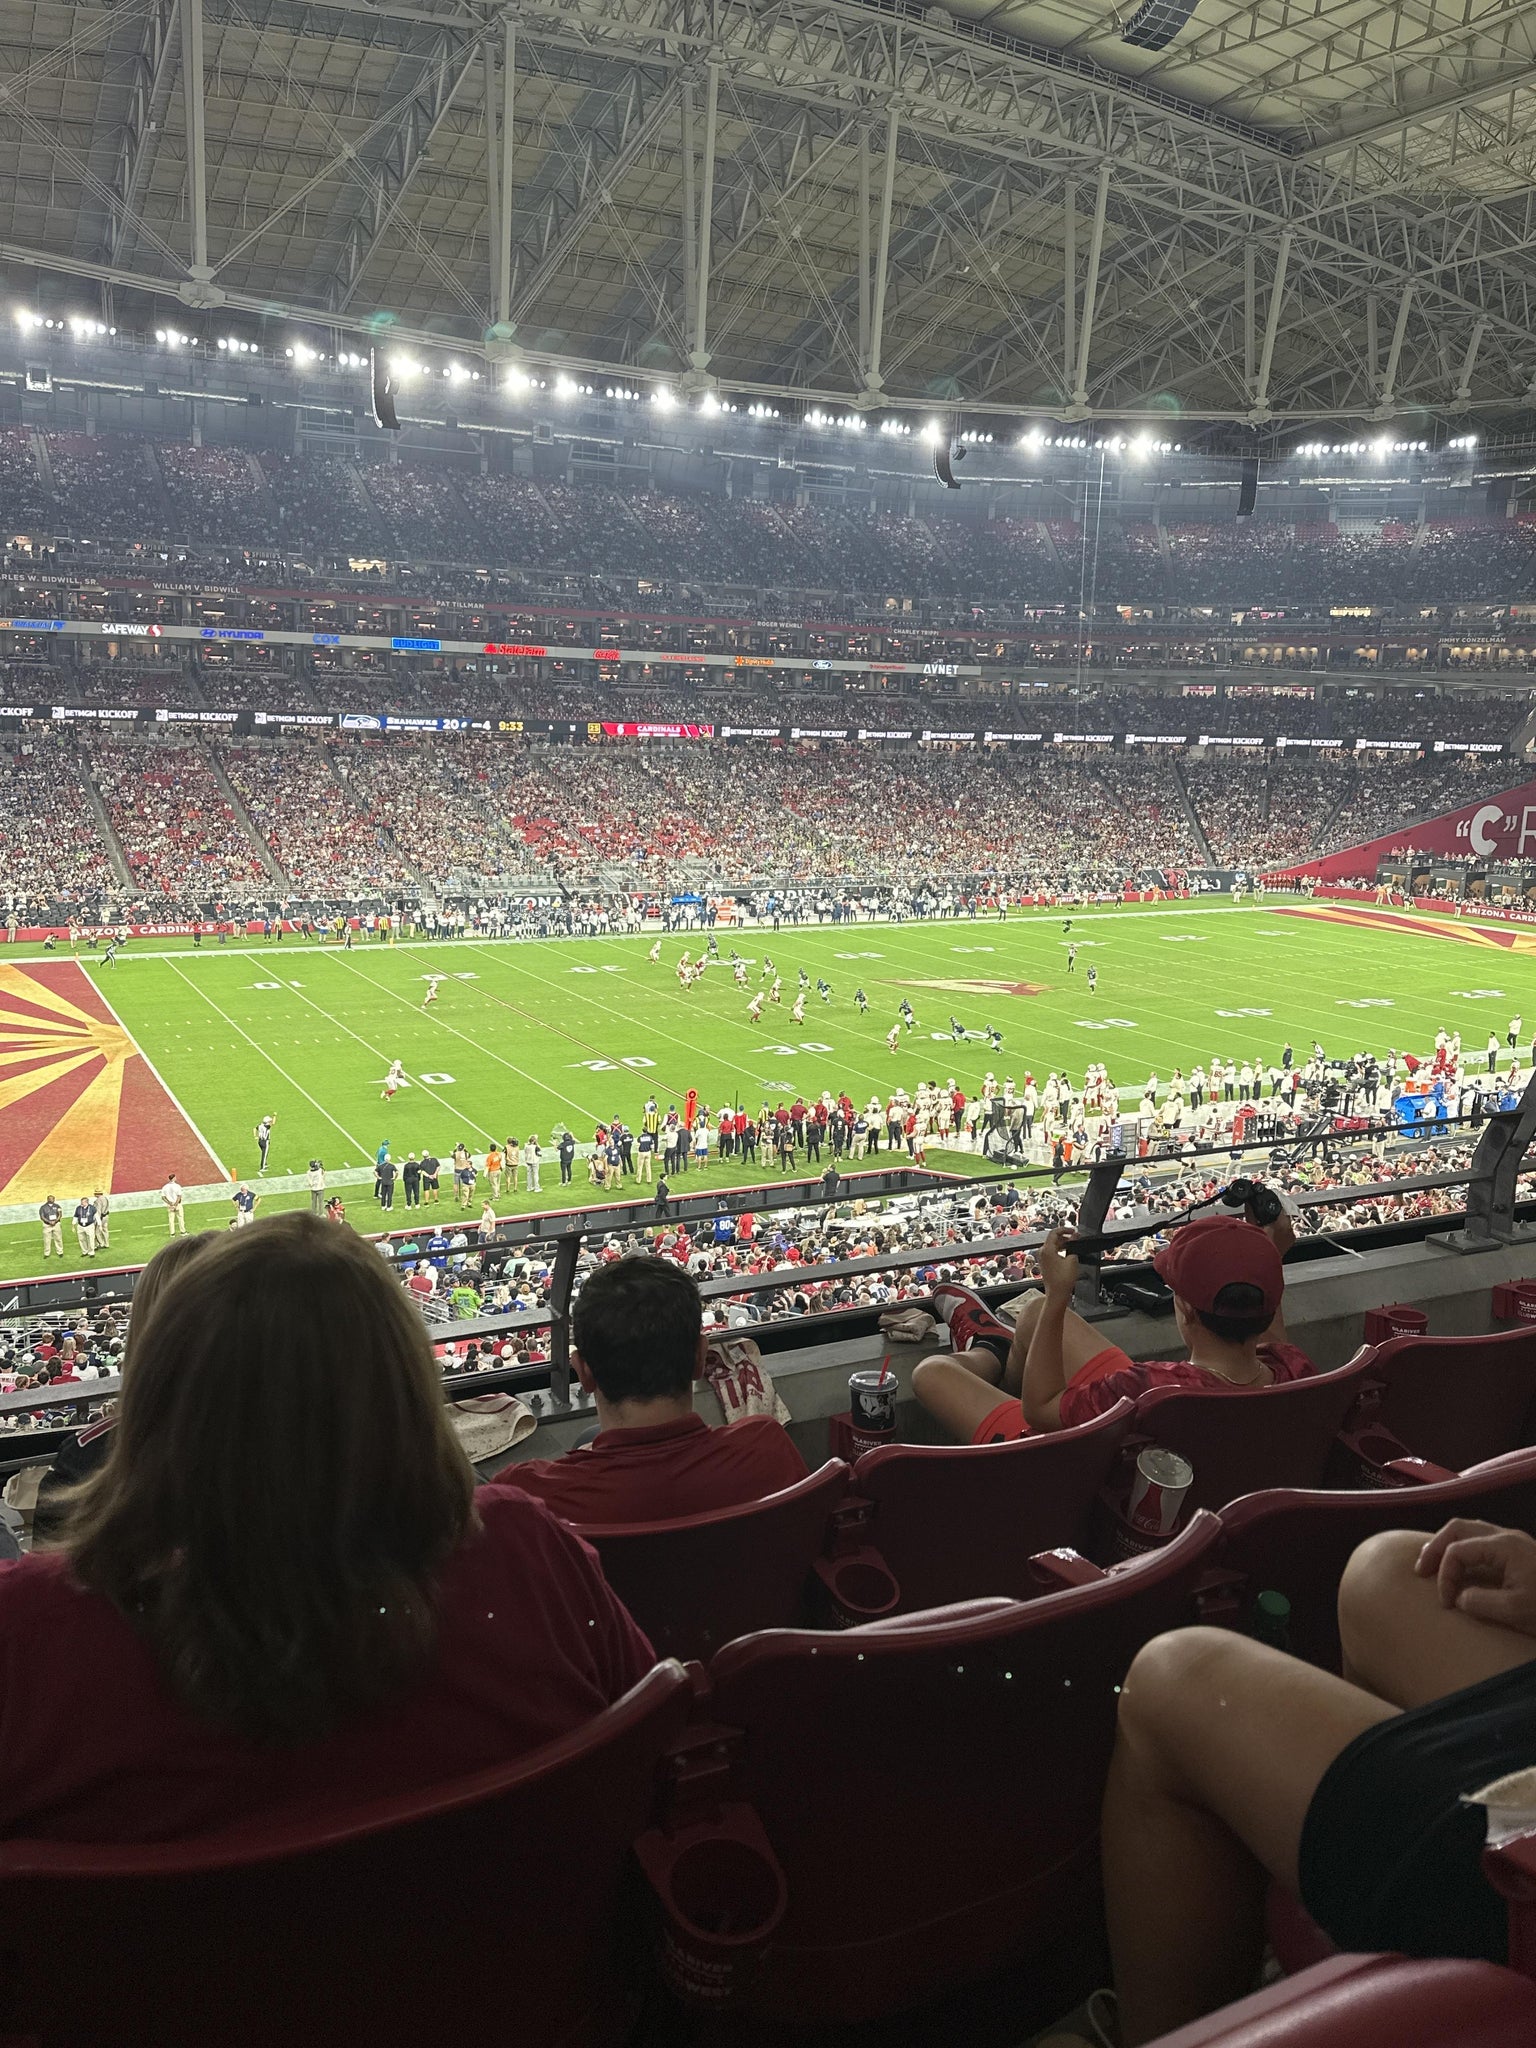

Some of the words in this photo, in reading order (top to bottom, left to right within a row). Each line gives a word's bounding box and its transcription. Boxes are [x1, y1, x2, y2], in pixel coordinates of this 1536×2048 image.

[42, 576, 82, 585] BIDWILL,
[153, 582, 192, 591] WILLIAM
[204, 585, 241, 594] BIDWILL
[452, 601, 485, 609] TILLMAN
[101, 623, 149, 635] SAFEWAY
[757, 620, 778, 628] ROGER
[778, 621, 803, 629] WEHRLI
[218, 630, 264, 640] HYUNDAI
[312, 633, 340, 645] COX
[923, 664, 959, 675] AVNET
[64, 709, 97, 718] BETMGM
[98, 709, 139, 719] KICKOFF
[168, 711, 199, 720] BETMGM
[199, 712, 239, 722] KICKOFF
[266, 714, 296, 723] BETMGM
[296, 715, 334, 724] KICKOFF
[386, 716, 438, 725] SEAHAWKS
[442, 718, 460, 730] 20
[482, 720, 491, 730] 4
[498, 721, 524, 731] 9:33
[617, 724, 625, 735] 6
[637, 725, 681, 733] CARDINALS
[752, 729, 780, 737] KICKOFF
[821, 730, 848, 738] KICKOFF
[950, 732, 975, 740] KICKOFF
[1013, 733, 1043, 741] KICKOFF
[1157, 736, 1187, 744] KICKOFF
[1232, 737, 1264, 745] KICKOFF
[1311, 739, 1343, 747] KICKOFF
[1390, 741, 1422, 749] KICKOFF
[1469, 743, 1503, 752] KICKOFF
[1465, 907, 1506, 918] ARIZONA
[1073, 1018, 1138, 1030] 50
[762, 1042, 835, 1056] 30
[580, 1056, 658, 1071] 20
[719, 1220, 731, 1231] 80
